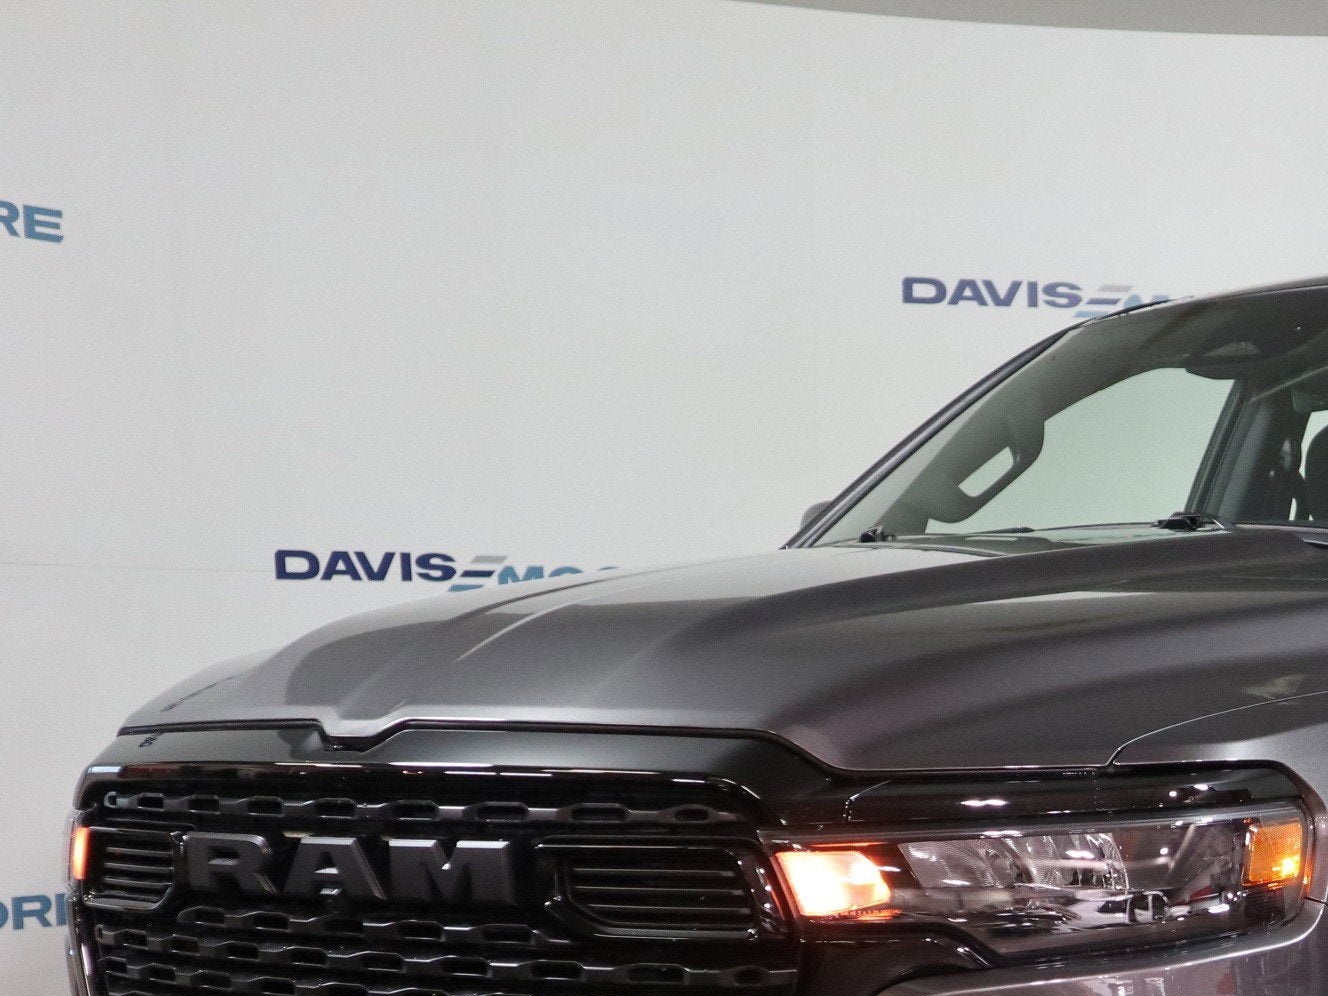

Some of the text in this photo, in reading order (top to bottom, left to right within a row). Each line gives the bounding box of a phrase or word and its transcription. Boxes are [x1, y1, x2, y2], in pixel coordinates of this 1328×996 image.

[902, 276, 1082, 309] DAVIS
[274, 550, 457, 582] DAVIS
[182, 831, 517, 906] RAM
